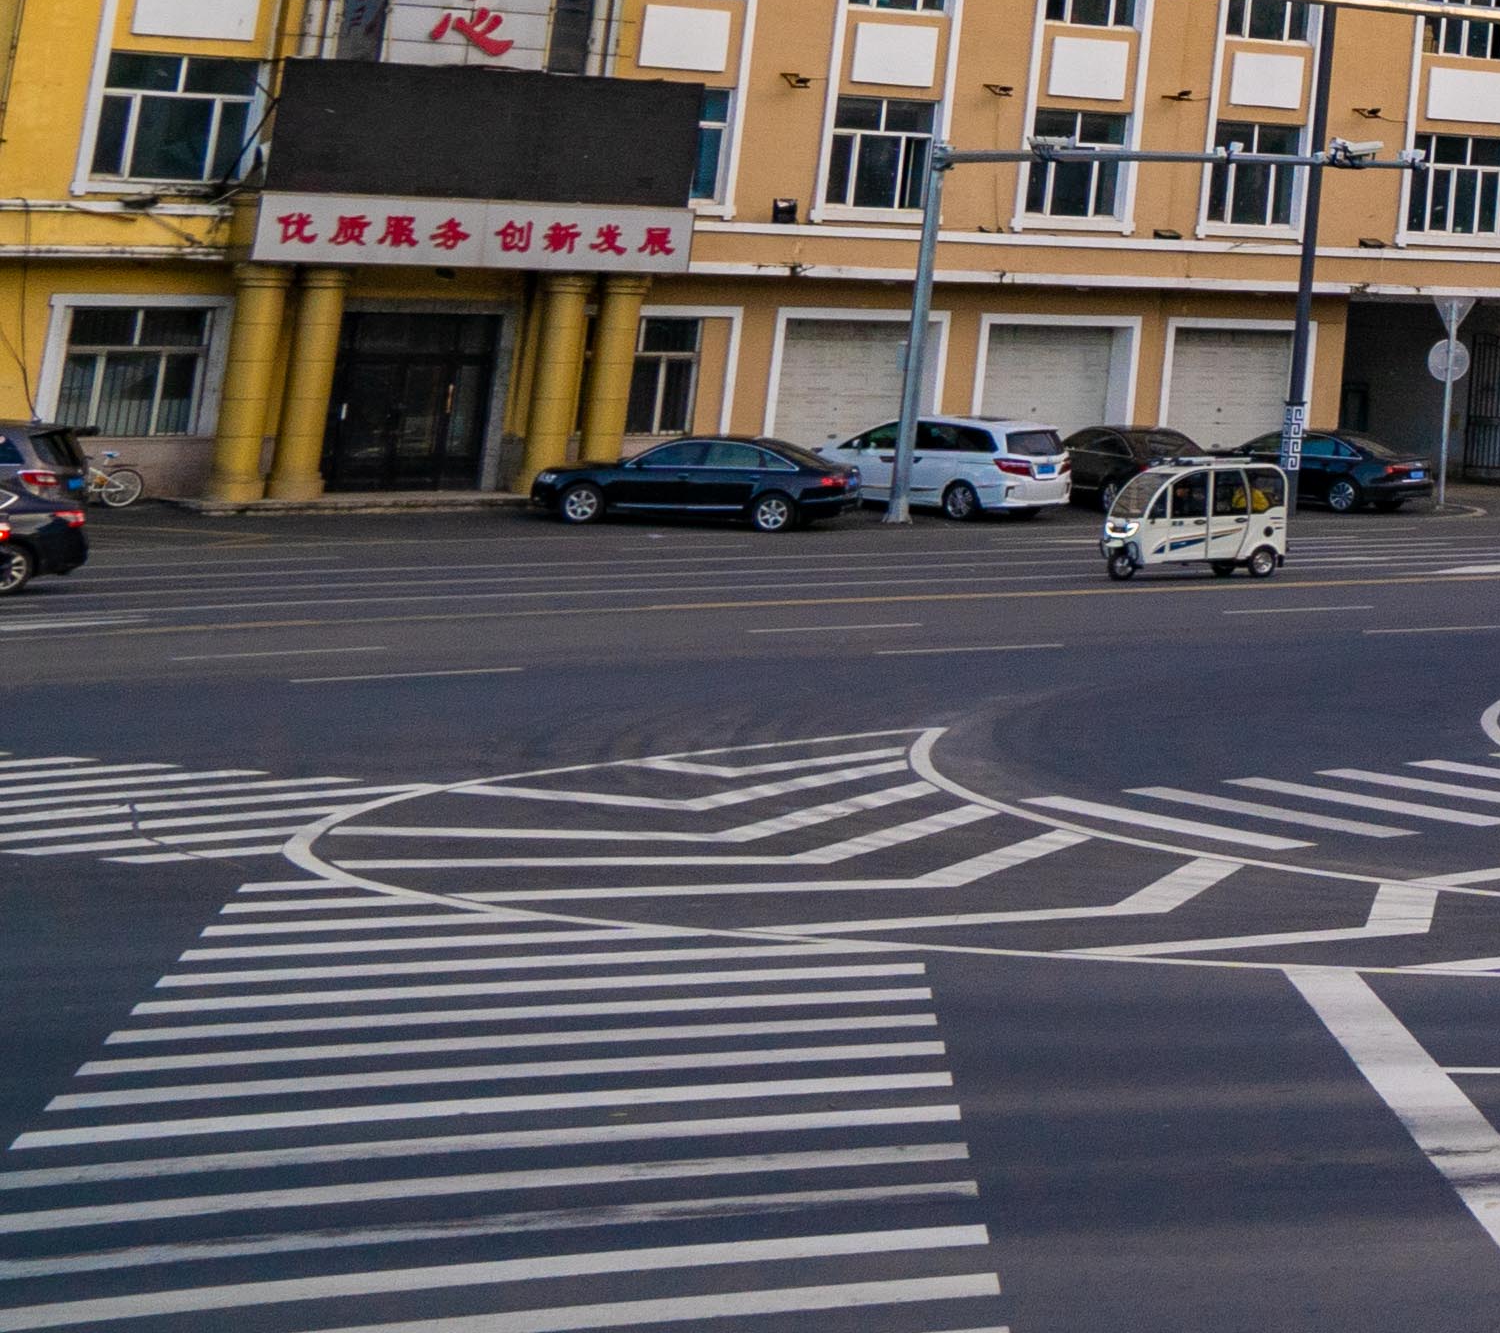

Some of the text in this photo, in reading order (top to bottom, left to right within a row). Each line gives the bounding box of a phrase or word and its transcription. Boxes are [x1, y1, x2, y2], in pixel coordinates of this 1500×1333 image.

[277, 212, 677, 259] 优质服务 创新发展
